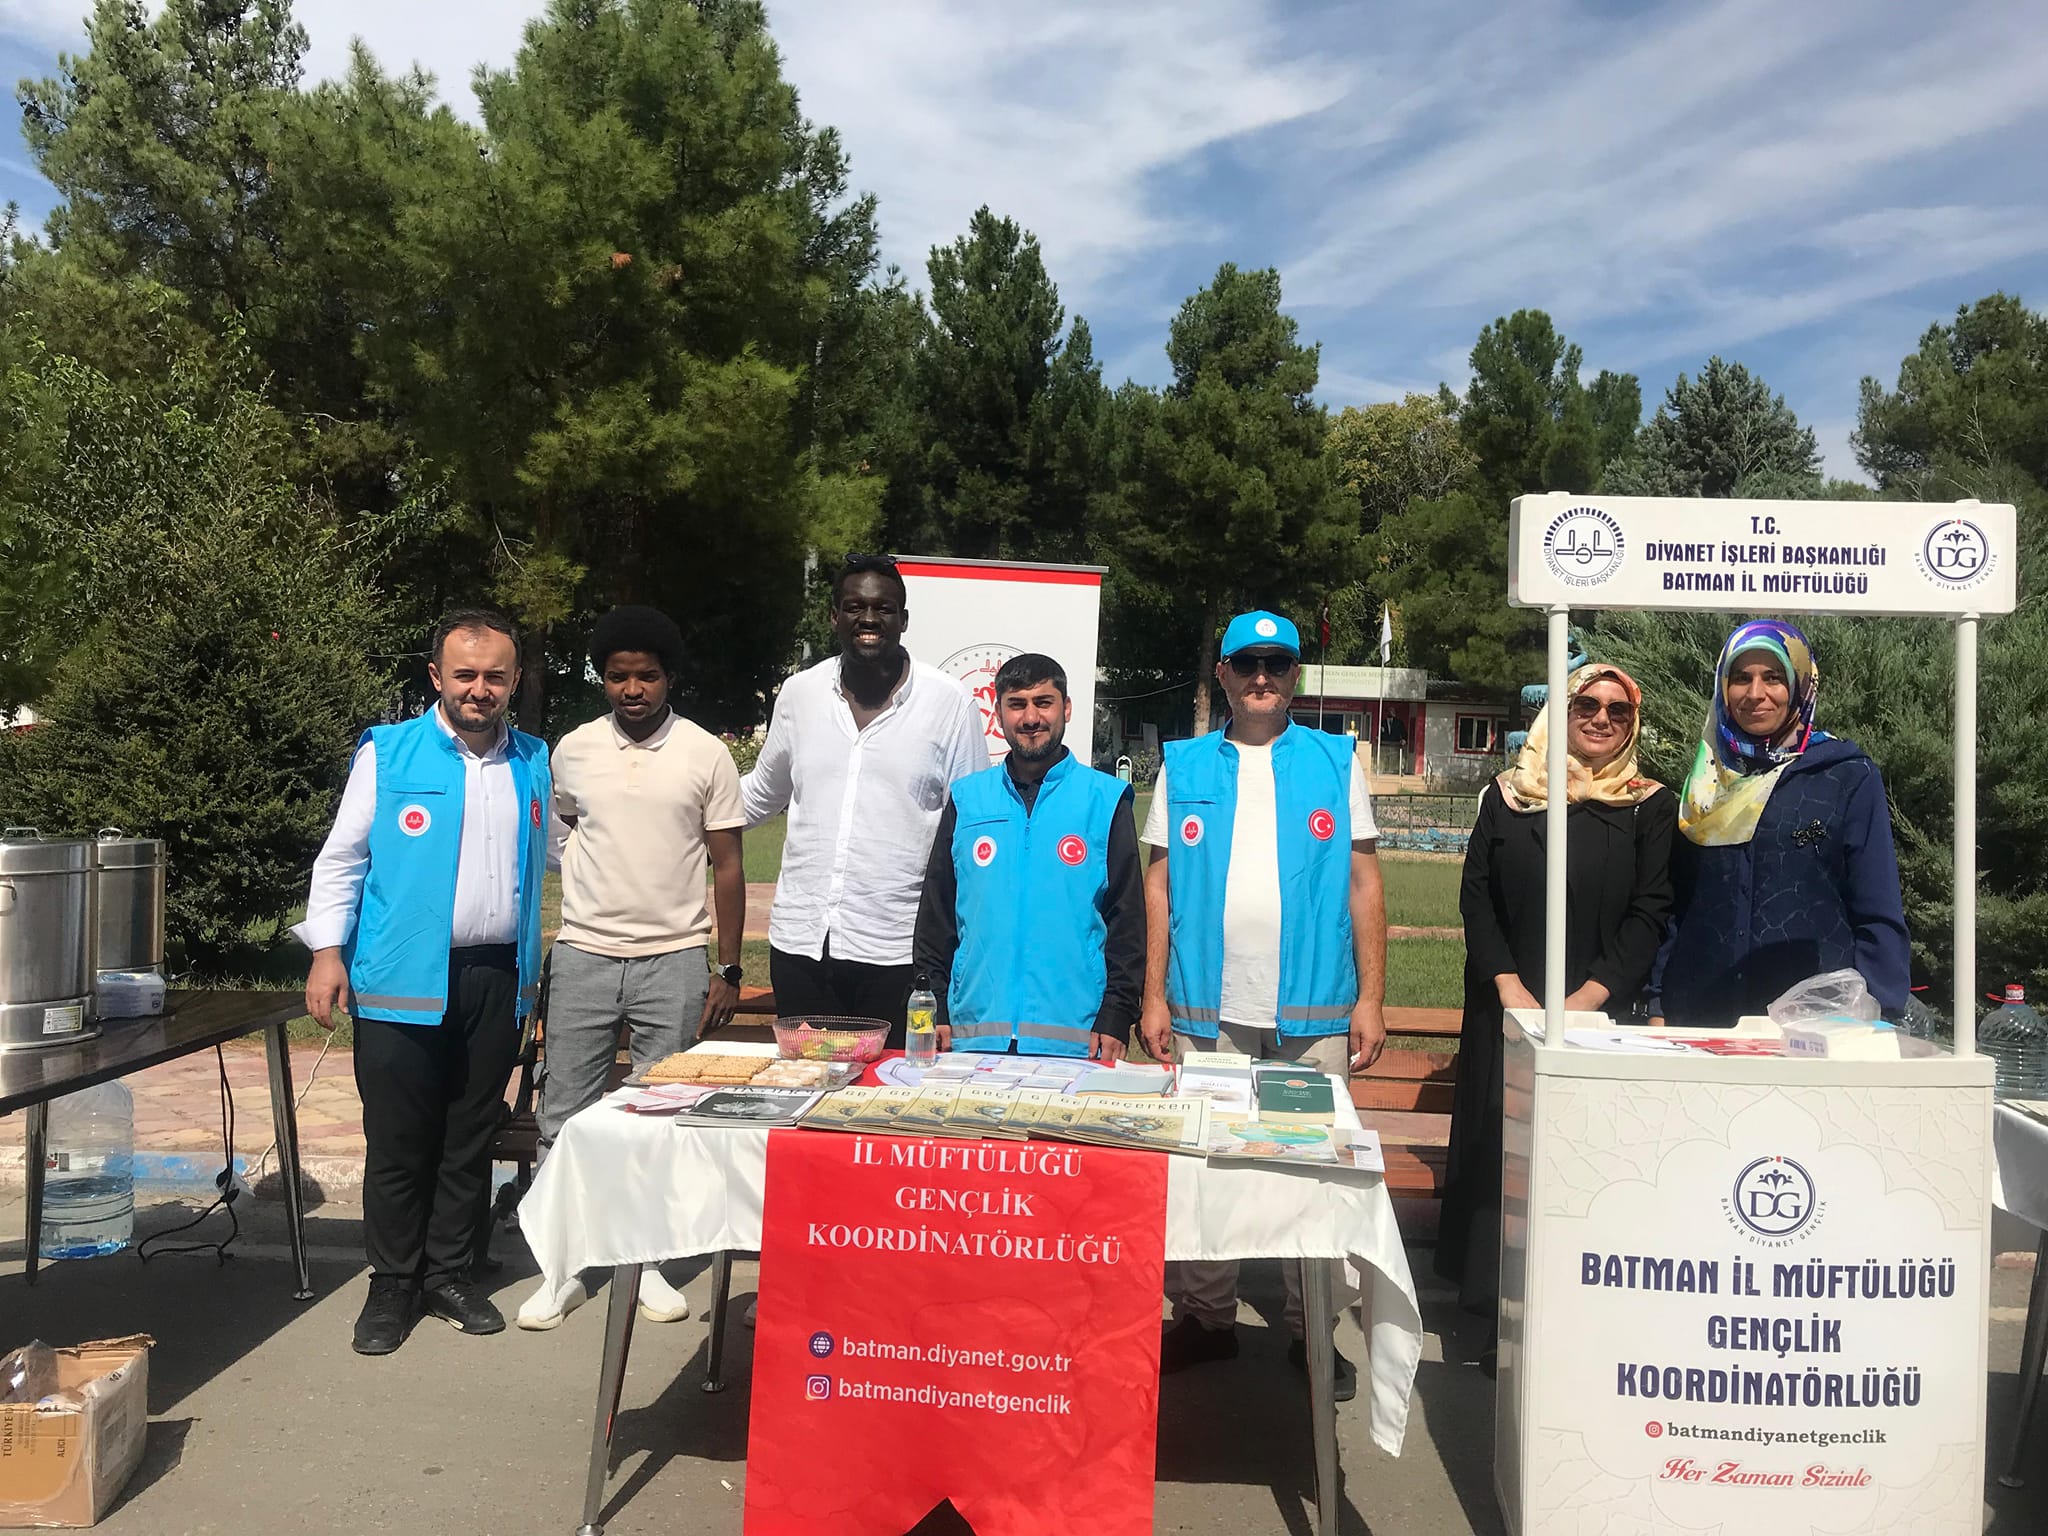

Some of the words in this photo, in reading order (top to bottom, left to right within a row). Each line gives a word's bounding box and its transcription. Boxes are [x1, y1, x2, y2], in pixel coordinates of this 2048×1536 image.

[1750, 516, 1781, 535] T.C.
[1543, 548, 1565, 579] DİYANET
[1563, 574, 1590, 587] İŞLERİ
[1645, 539, 1715, 562] DİYANET
[1721, 541, 1776, 566] İŞLERİ
[1782, 543, 1887, 568] BAŞKANLIĞI
[1936, 546, 1978, 569] DG
[1663, 572, 1735, 592] BATMAN
[1741, 570, 1757, 592] İL
[1763, 571, 1869, 594] MÜFTÜLÜĞÜ
[852, 1141, 882, 1166] İL
[889, 1142, 1083, 1177] MÜFTÜLÜĞÜ
[895, 1185, 1035, 1218] GENÇLİK
[1747, 1190, 1802, 1219] DG
[1720, 1197, 1746, 1236] BATMAN
[1748, 1237, 1795, 1248] DİYANET
[807, 1223, 1121, 1265] KOORDİNATÖRLÜĞÜ
[1581, 1252, 1719, 1294] BATMAN
[1732, 1255, 1761, 1297] İL
[1773, 1257, 1956, 1300] MÜFTÜLÜĞÜ
[1706, 1312, 1842, 1358] GENÇLİK
[842, 1335, 1072, 1372] batman.diyanet.gov.tr
[838, 1378, 1071, 1415] batmandiyanetgenclik
[1617, 1363, 1922, 1408] KOORDİNATÖRLÜĞÜ
[2, 1416, 14, 1458] TÜRKİYE
[1667, 1422, 1887, 1448] batmandiyanetgenclik
[1659, 1458, 1708, 1482] Her
[1711, 1461, 1795, 1487] Zaman
[1801, 1464, 1873, 1487] Sizinle
